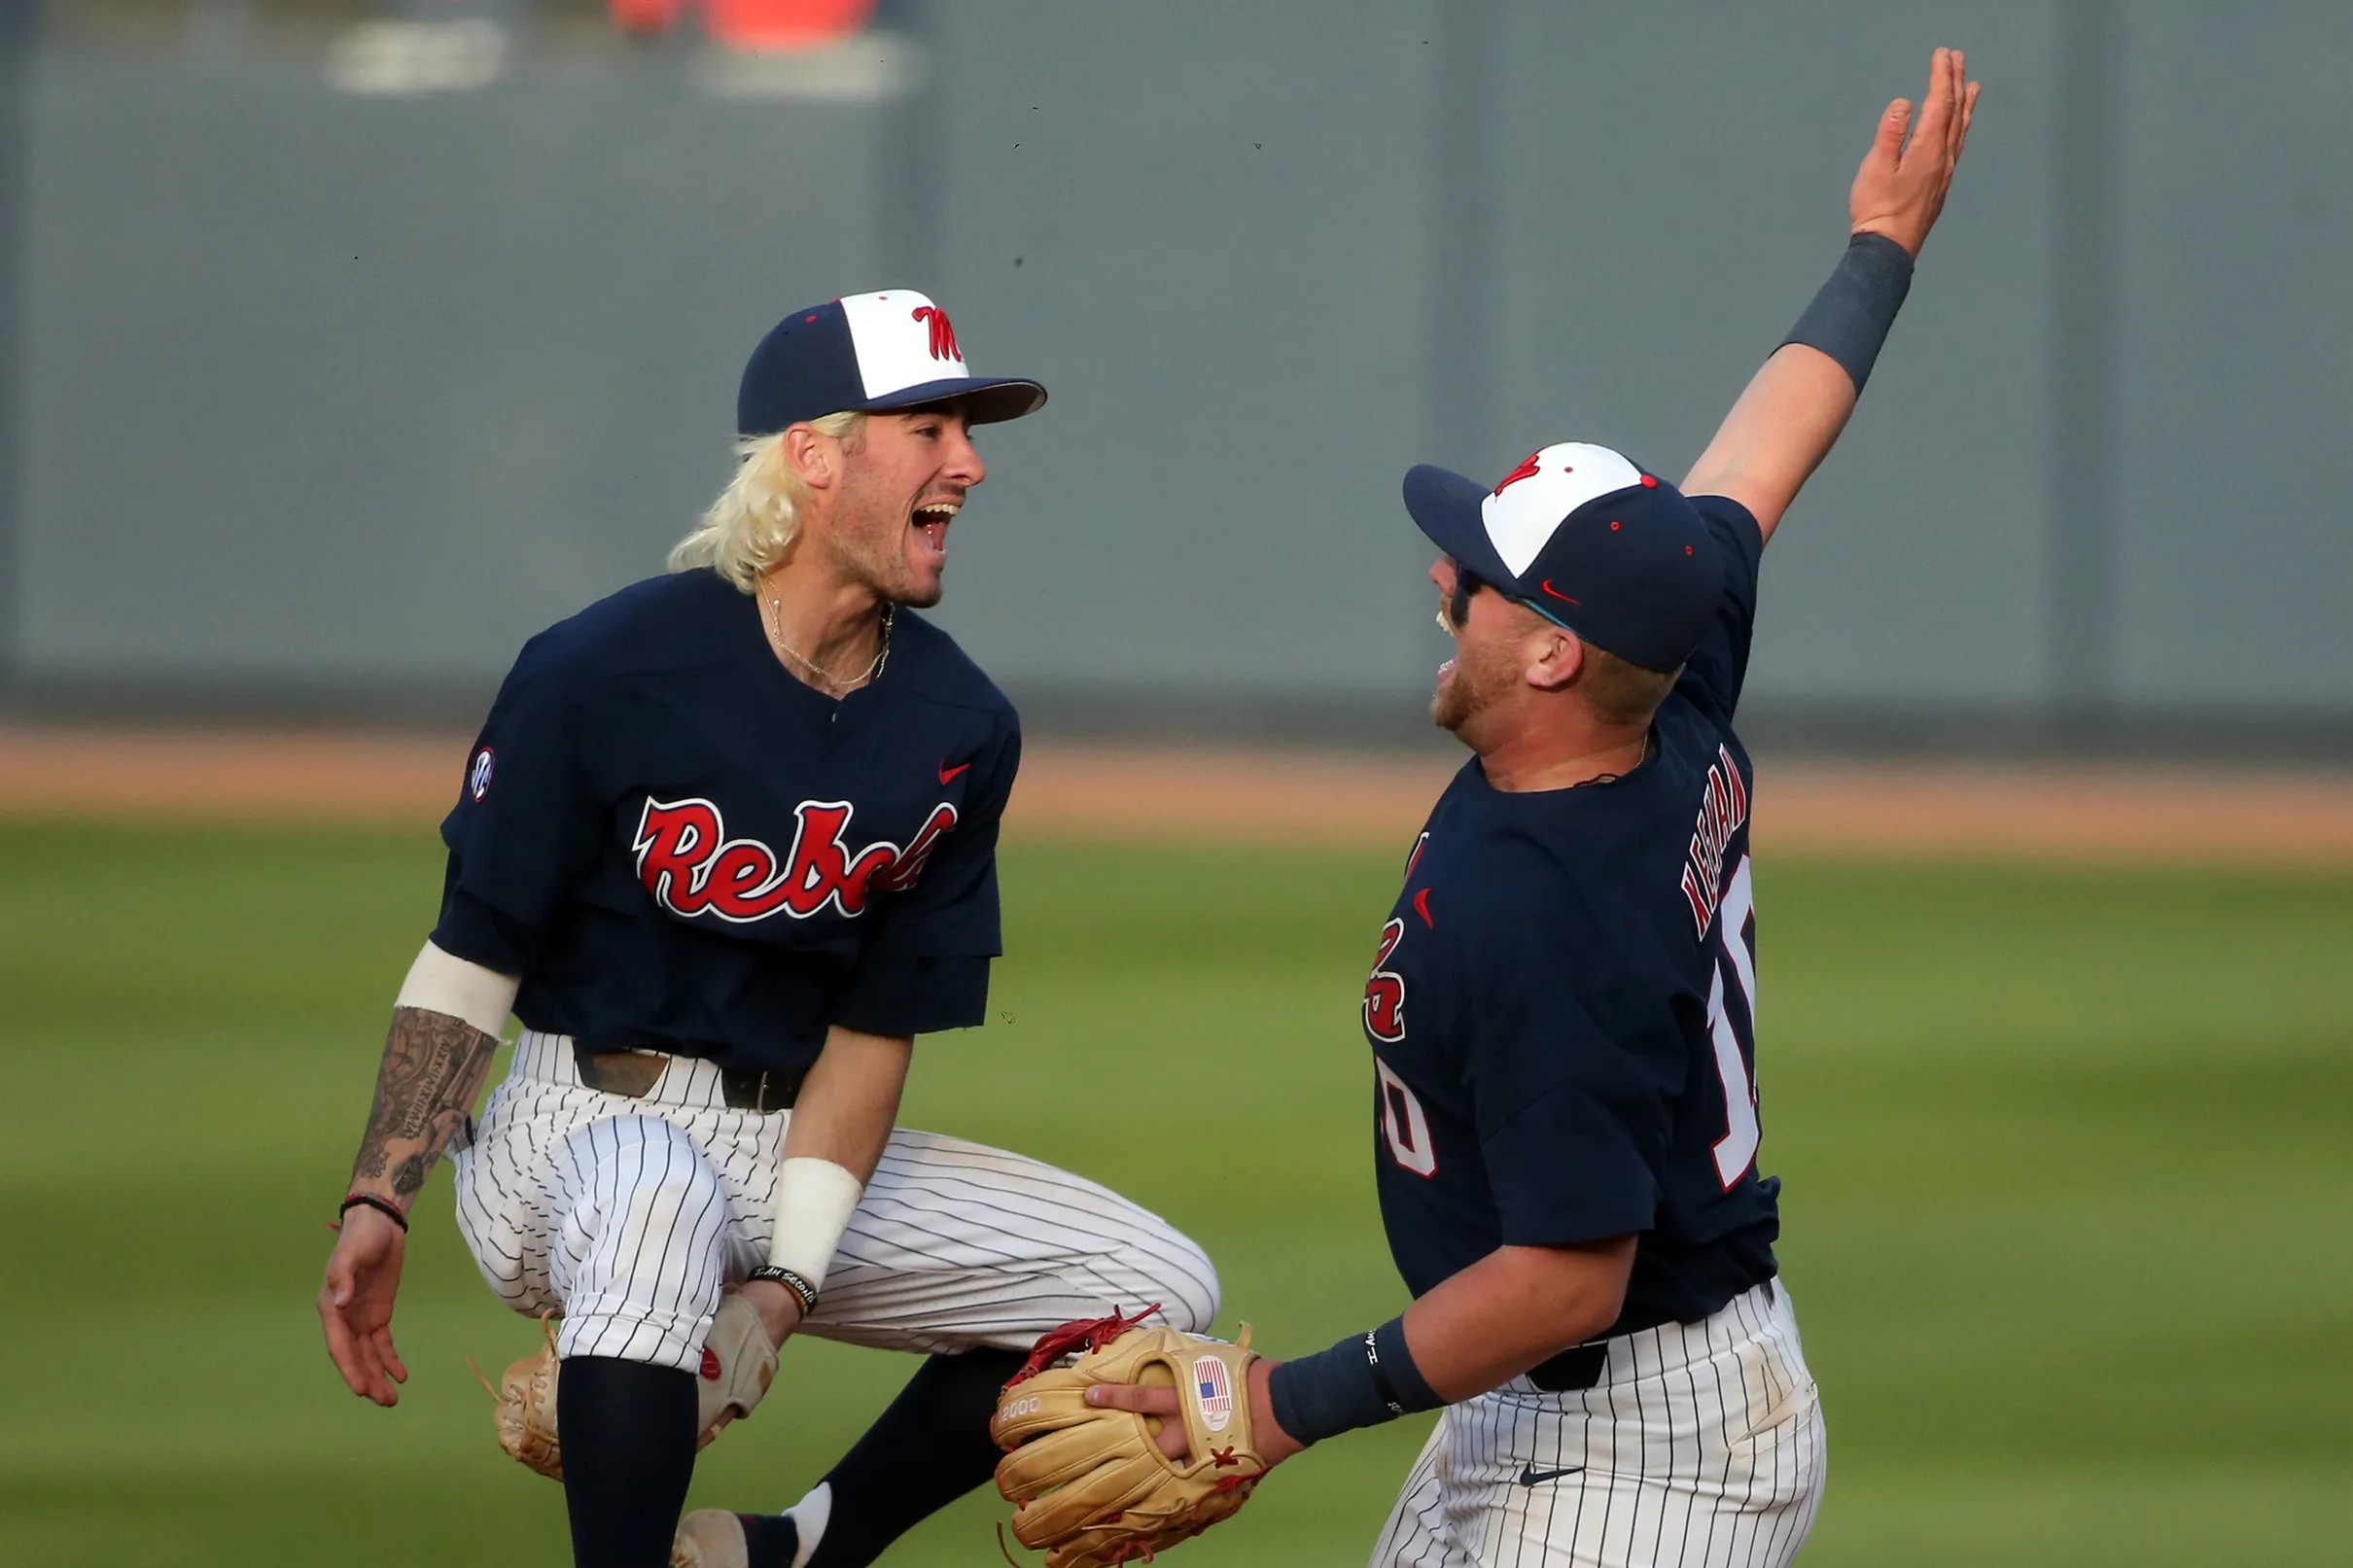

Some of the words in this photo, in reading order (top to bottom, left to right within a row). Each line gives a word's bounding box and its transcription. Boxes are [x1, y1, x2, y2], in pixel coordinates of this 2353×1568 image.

[911, 305, 963, 363] M
[1374, 1055, 1439, 1180] 0
[764, 1267, 782, 1276] AM
